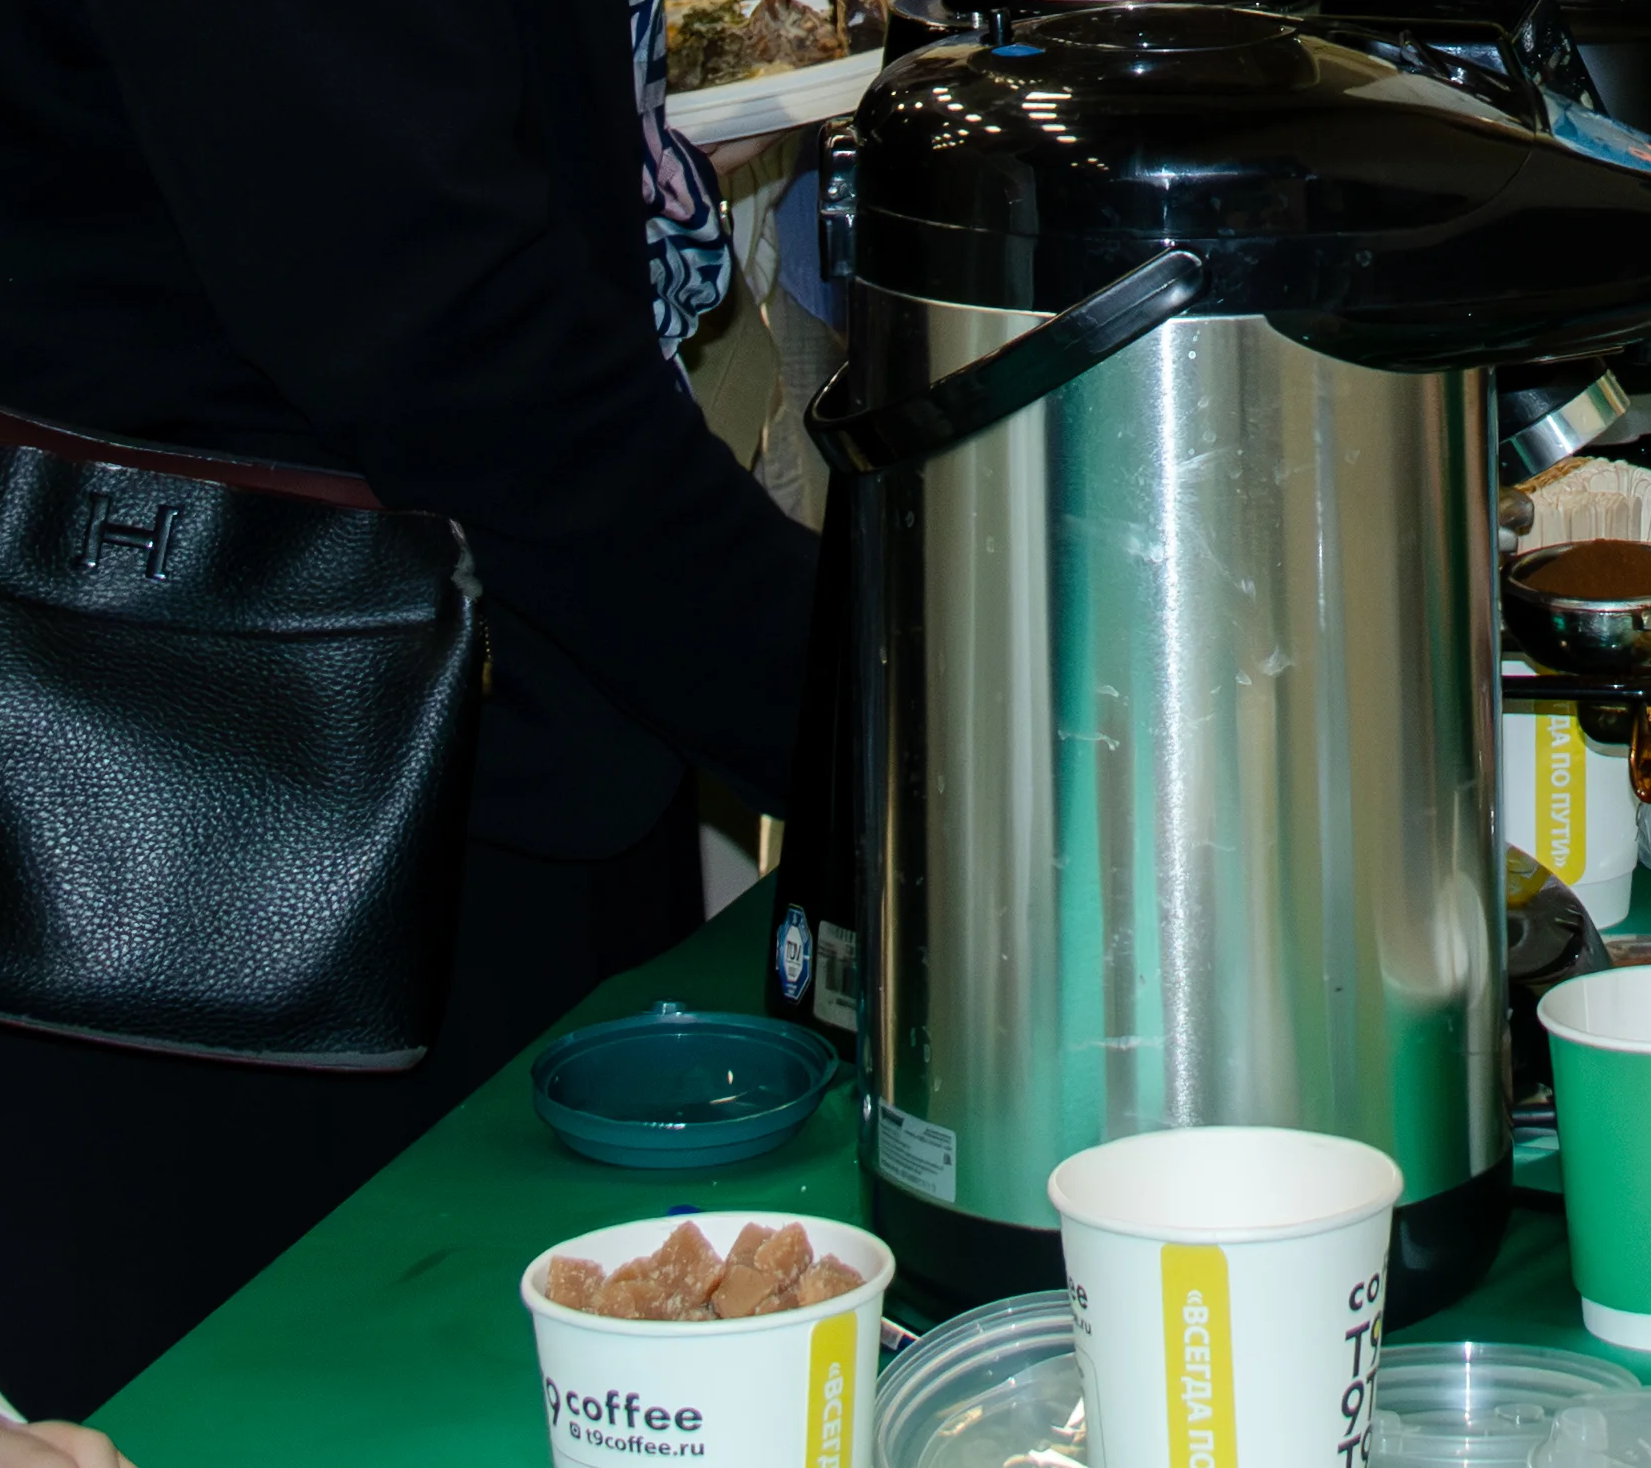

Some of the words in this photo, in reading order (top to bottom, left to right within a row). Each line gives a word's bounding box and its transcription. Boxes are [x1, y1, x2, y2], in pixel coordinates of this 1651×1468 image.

[1551, 752, 1571, 787] ПО
[1550, 793, 1572, 869] ПУТИ»
[1180, 1289, 1213, 1423] «ВСЕГДА
[566, 1389, 704, 1432] coffee
[586, 1427, 705, 1456] t9coffee.ru
